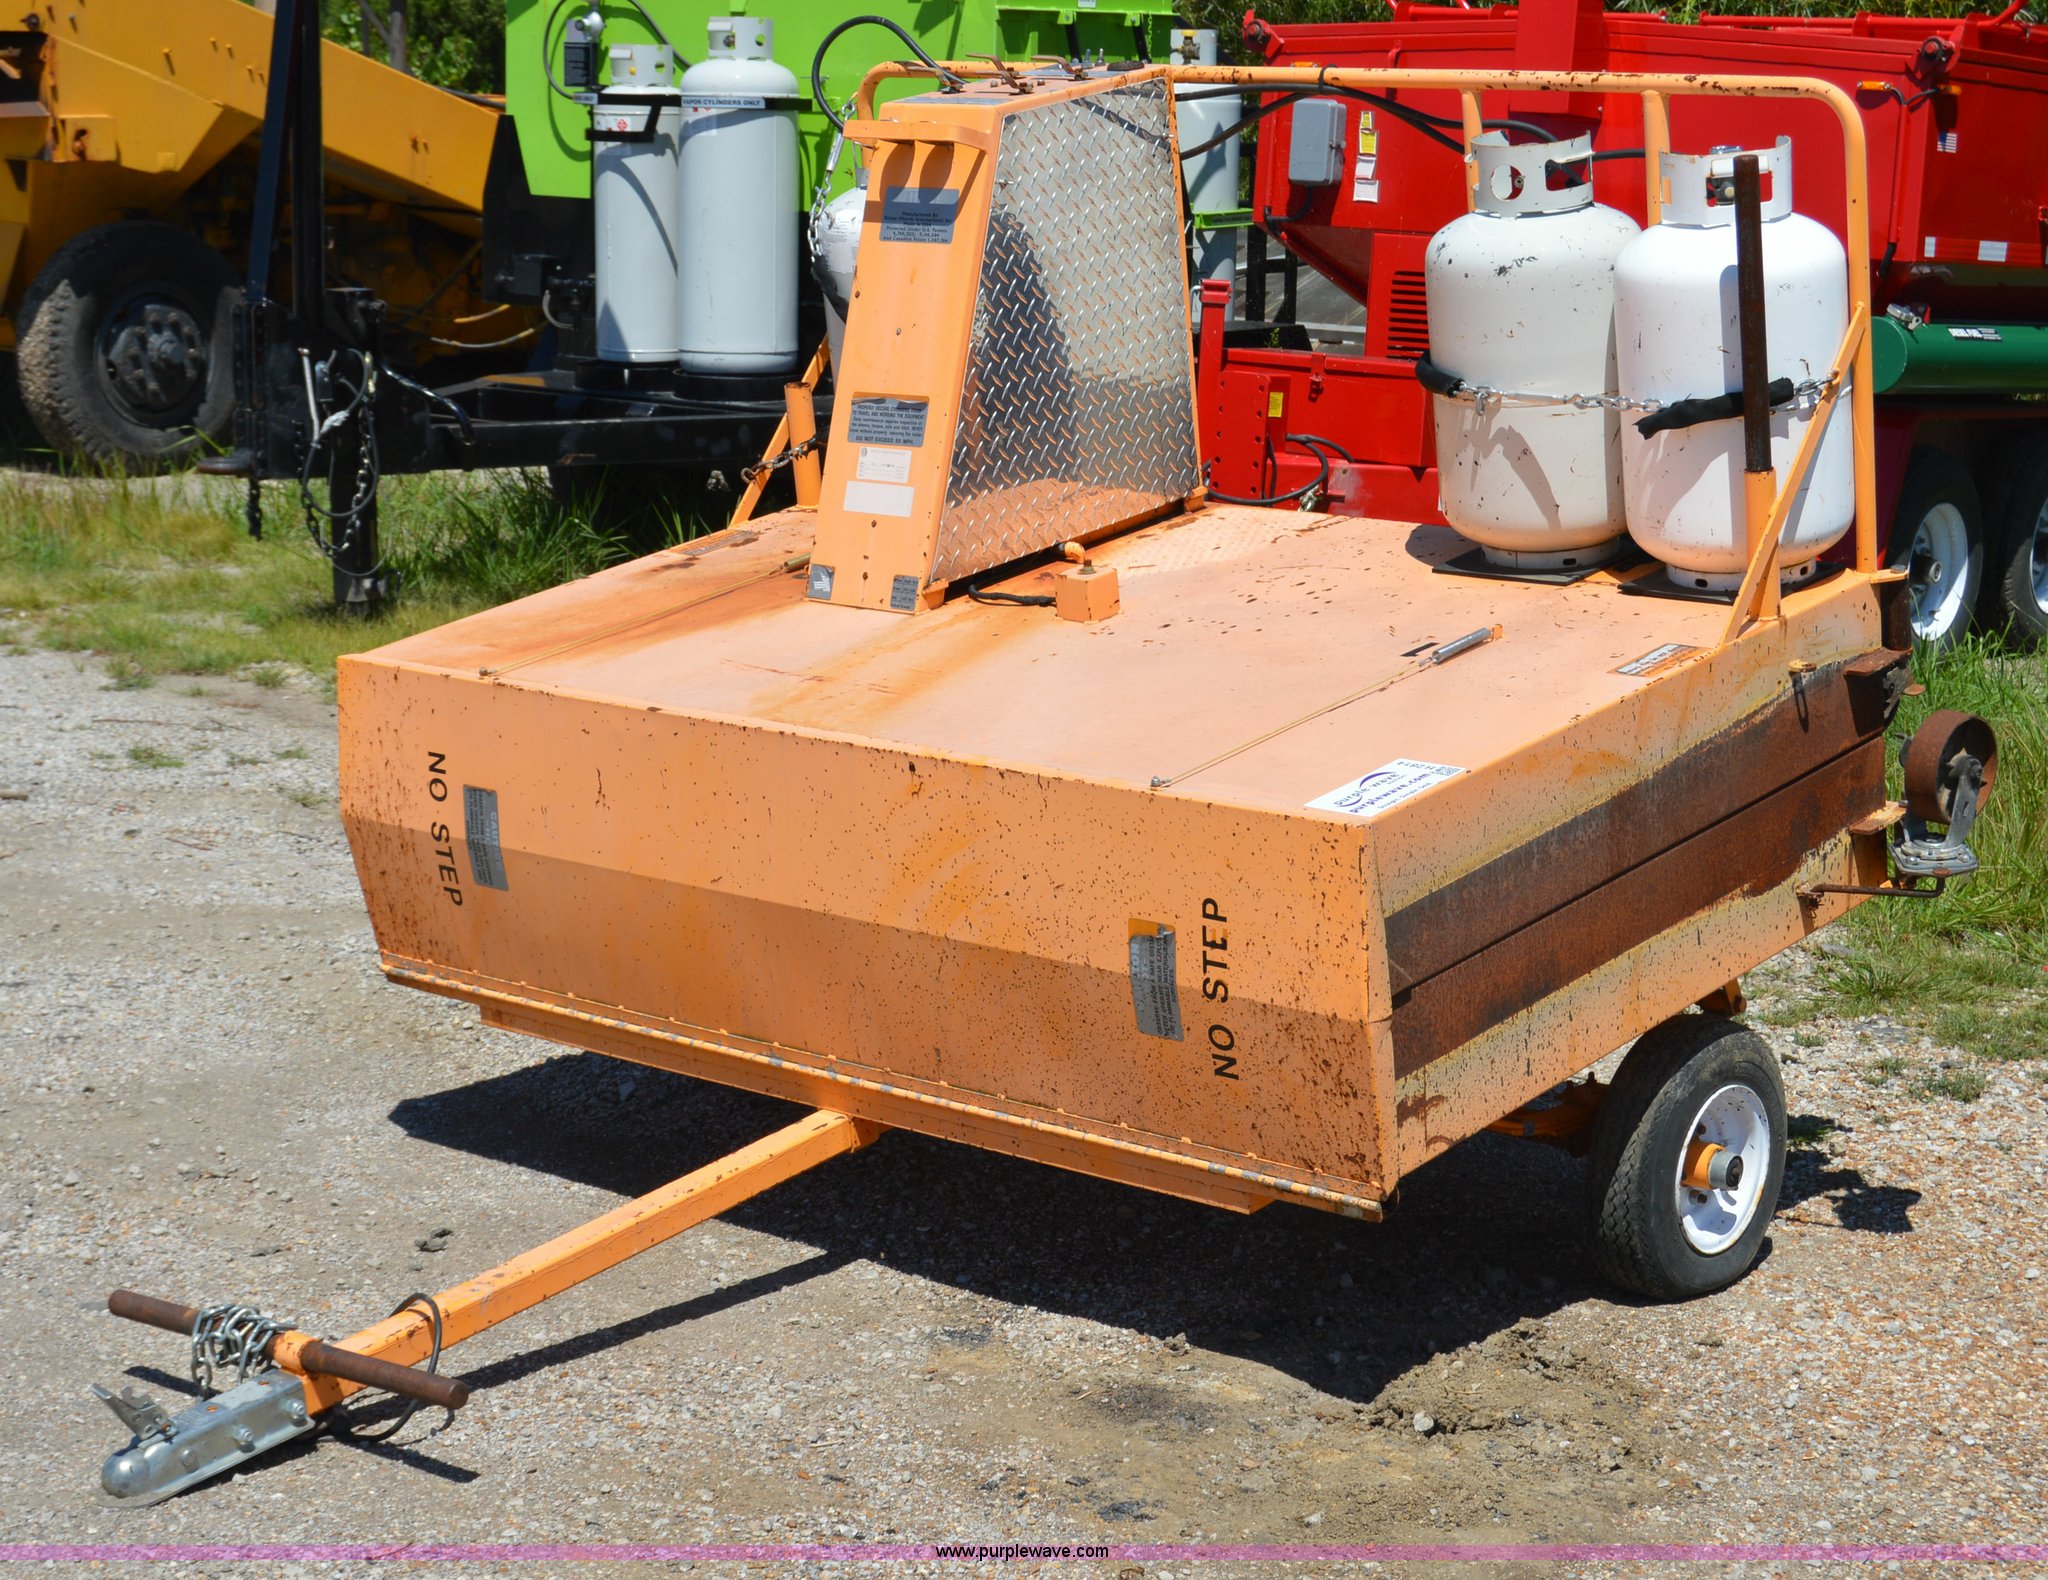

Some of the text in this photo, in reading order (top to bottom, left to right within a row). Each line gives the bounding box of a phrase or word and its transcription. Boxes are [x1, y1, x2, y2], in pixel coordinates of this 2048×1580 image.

[428, 752, 463, 906] NO STEP
[1334, 772, 1400, 807] purple wave
[1349, 773, 1431, 813] purplewave.com
[1202, 898, 1239, 1080] NO STEP
